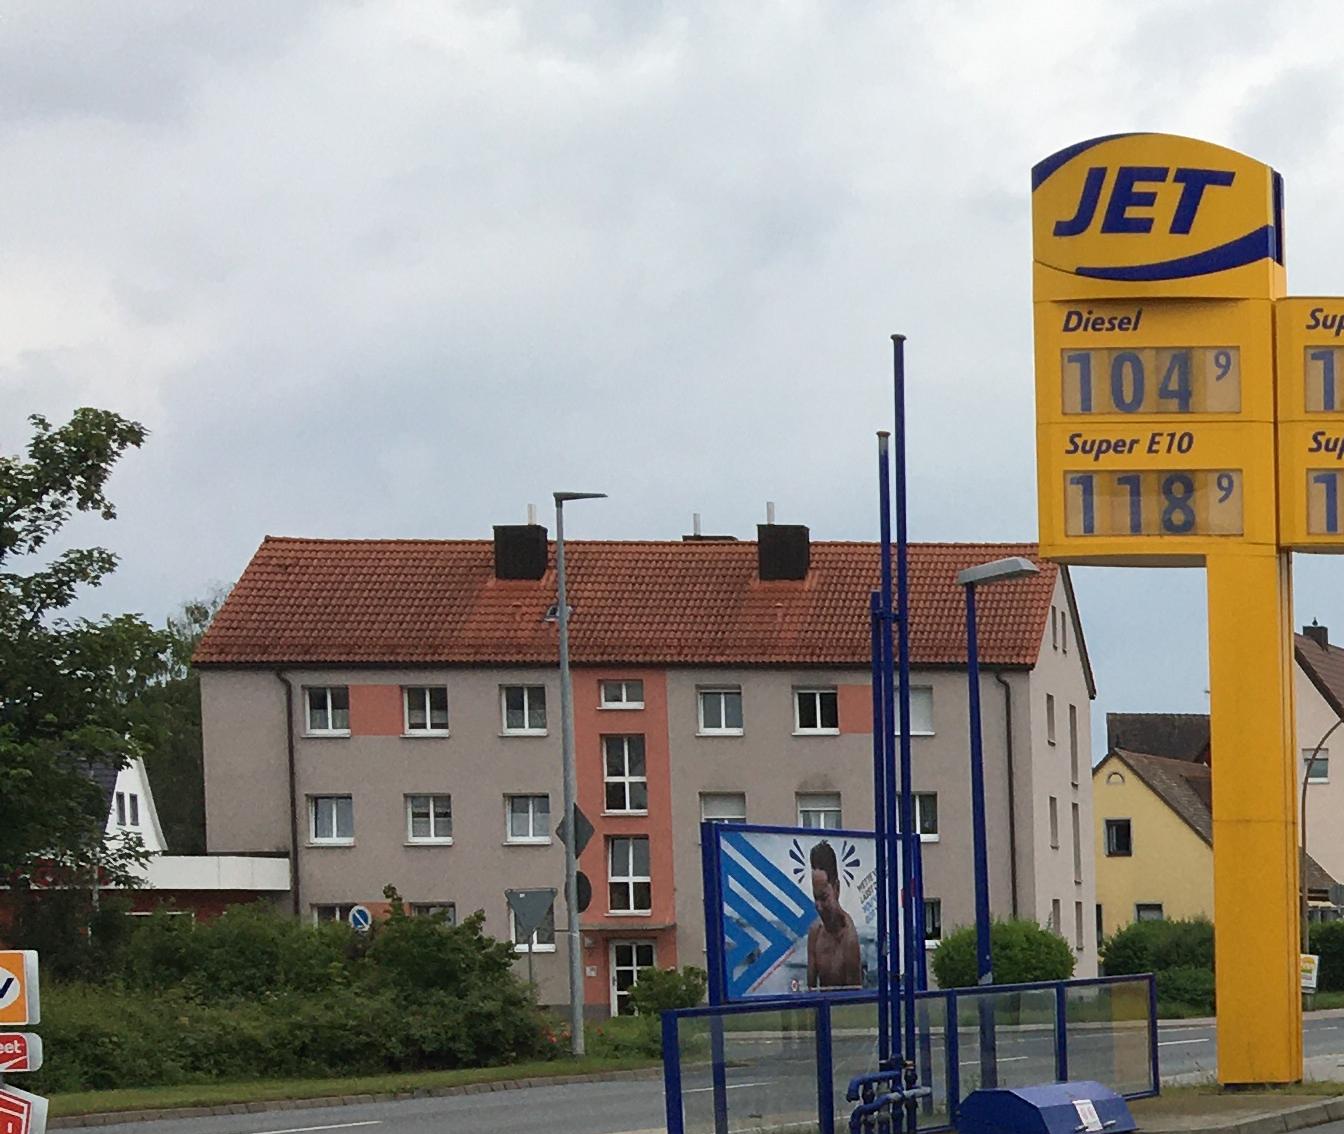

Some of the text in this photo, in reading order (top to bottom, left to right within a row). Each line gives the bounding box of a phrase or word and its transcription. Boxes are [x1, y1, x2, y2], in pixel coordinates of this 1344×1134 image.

[1052, 166, 1236, 237] JET
[1062, 308, 1143, 332] Diesel
[1065, 431, 1195, 462] Super E10
